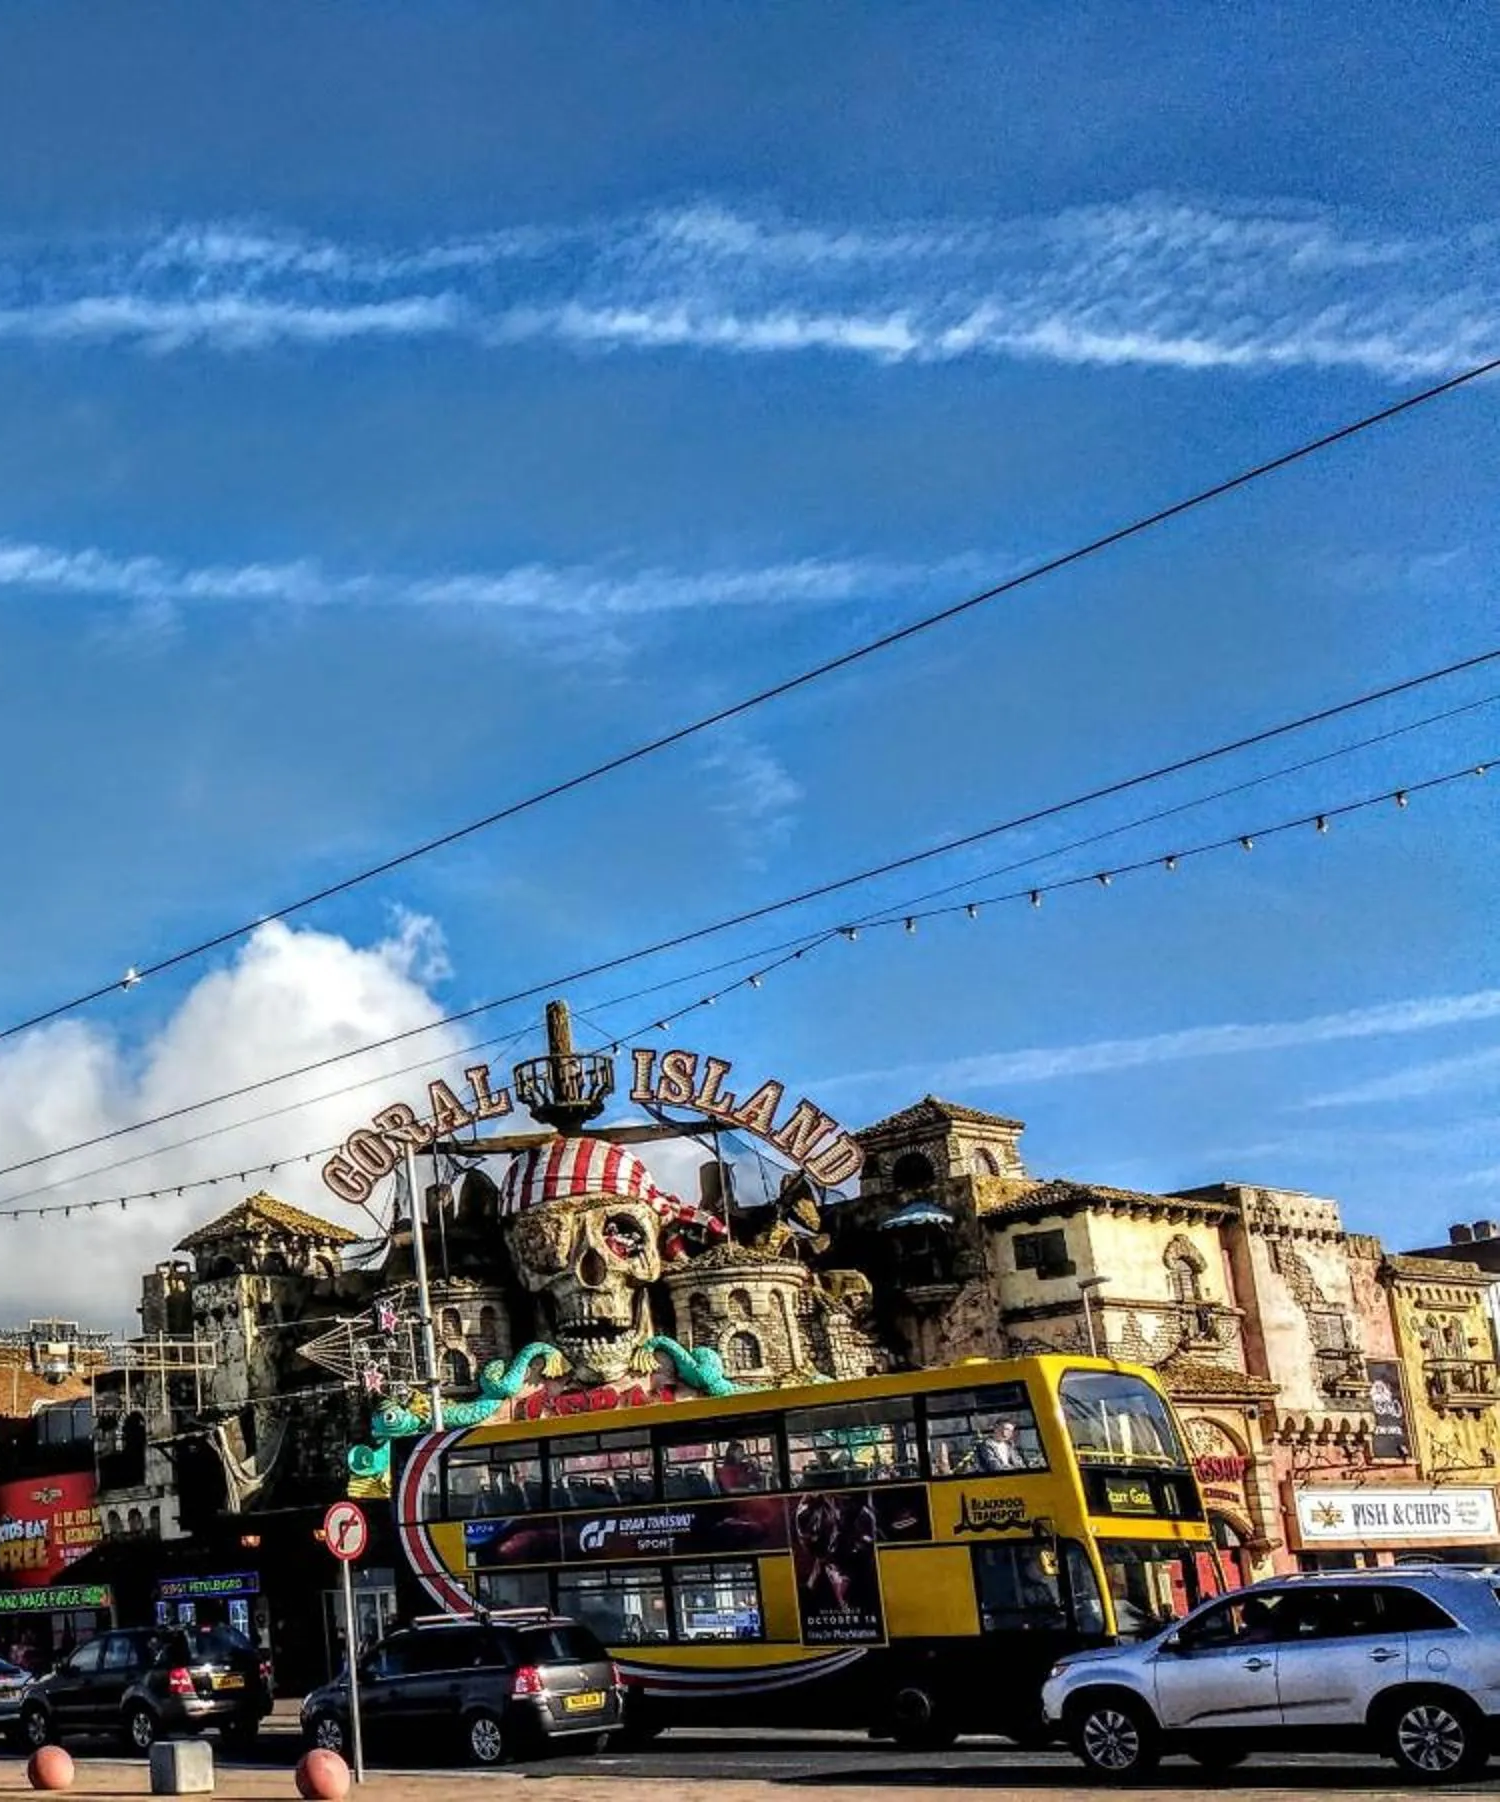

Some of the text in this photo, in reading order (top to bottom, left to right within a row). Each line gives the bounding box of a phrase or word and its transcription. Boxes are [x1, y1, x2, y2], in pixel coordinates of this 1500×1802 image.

[322, 1049, 866, 1204] CORAL ISLAND
[971, 1497, 1025, 1511] BLACKPOOL
[619, 1513, 692, 1531] GRAN TURISMO
[973, 1510, 1025, 1522] TRANSPORT
[1351, 1503, 1388, 1527] FISH
[1393, 1503, 1405, 1526] &
[1405, 1503, 1451, 1526] CHIPS
[25, 1518, 49, 1539] EAT
[807, 1615, 859, 1625] OCTOBER
